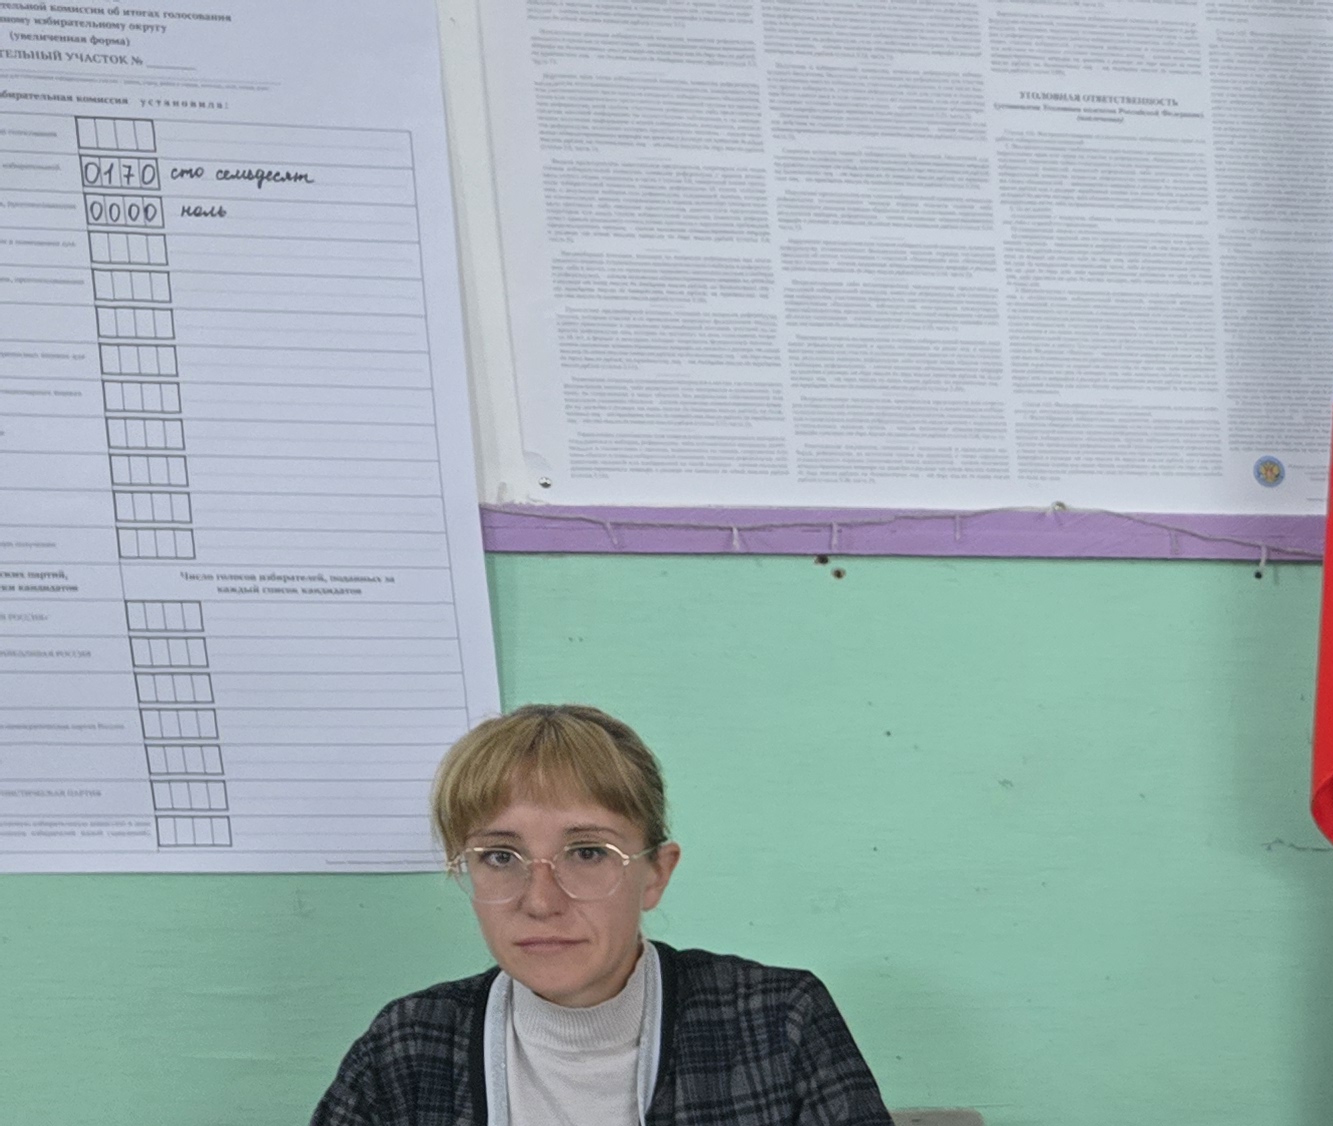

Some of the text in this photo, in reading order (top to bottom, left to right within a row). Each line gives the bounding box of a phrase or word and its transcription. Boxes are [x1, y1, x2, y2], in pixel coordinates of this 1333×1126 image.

[50, 5, 105, 15] комиссии
[107, 7, 119, 16] об
[123, 9, 160, 18] итогах
[163, 11, 232, 22] голосования
[34, 17, 126, 31] избирательному
[128, 23, 167, 33] округу
[10, 31, 130, 47] (увеличенная форма)
[65, 52, 128, 65] УЧАСТОК
[84, 161, 156, 186] 0170
[170, 167, 315, 190] сто семьдесят
[89, 200, 158, 223] 0000
